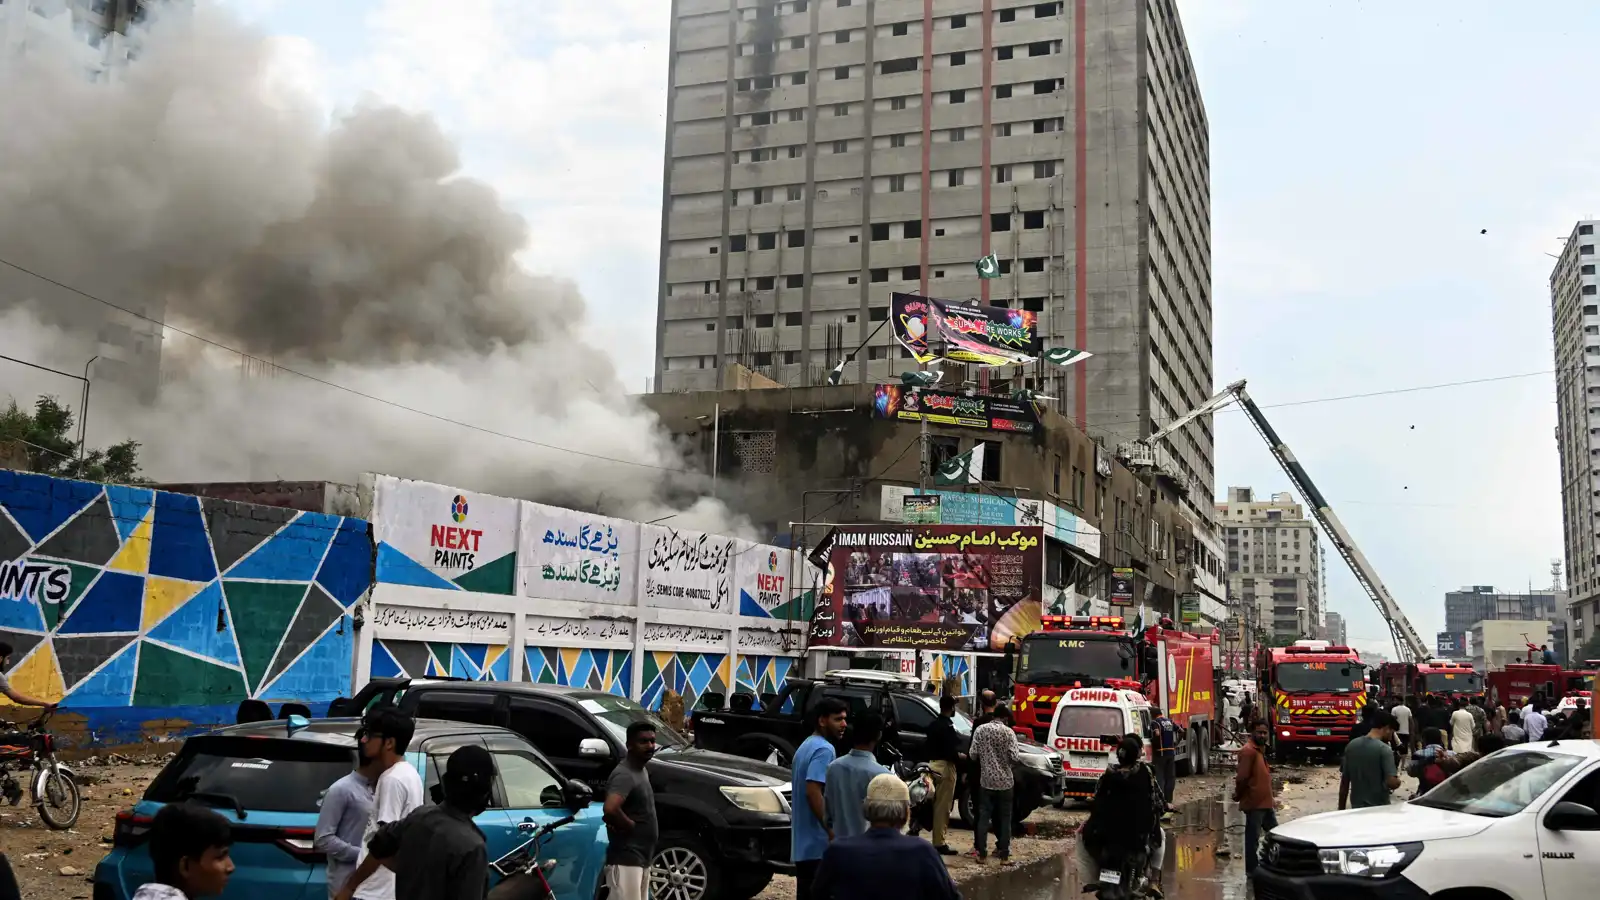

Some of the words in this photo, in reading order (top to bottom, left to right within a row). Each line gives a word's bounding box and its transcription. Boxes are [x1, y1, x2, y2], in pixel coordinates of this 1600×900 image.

[997, 327, 1022, 338] WORKS
[430, 523, 483, 552] NEXT
[542, 529, 577, 548] سندھ
[839, 533, 870, 547] IMAM
[871, 533, 913, 547] HUSSAIN
[961, 531, 996, 551] امام
[997, 530, 1038, 550] موکب
[434, 548, 475, 571] PAINTS
[542, 563, 578, 581] سندھ
[656, 584, 672, 596] SEMIS
[673, 586, 684, 598] CODE
[757, 573, 785, 593] NEXT
[710, 577, 729, 610] اسکول
[758, 590, 780, 606] PAINTS
[1059, 639, 1086, 648] KMC
[1438, 642, 1454, 651] ZIC
[1070, 690, 1118, 702] CHHIPA
[1542, 851, 1575, 859] HILUX
